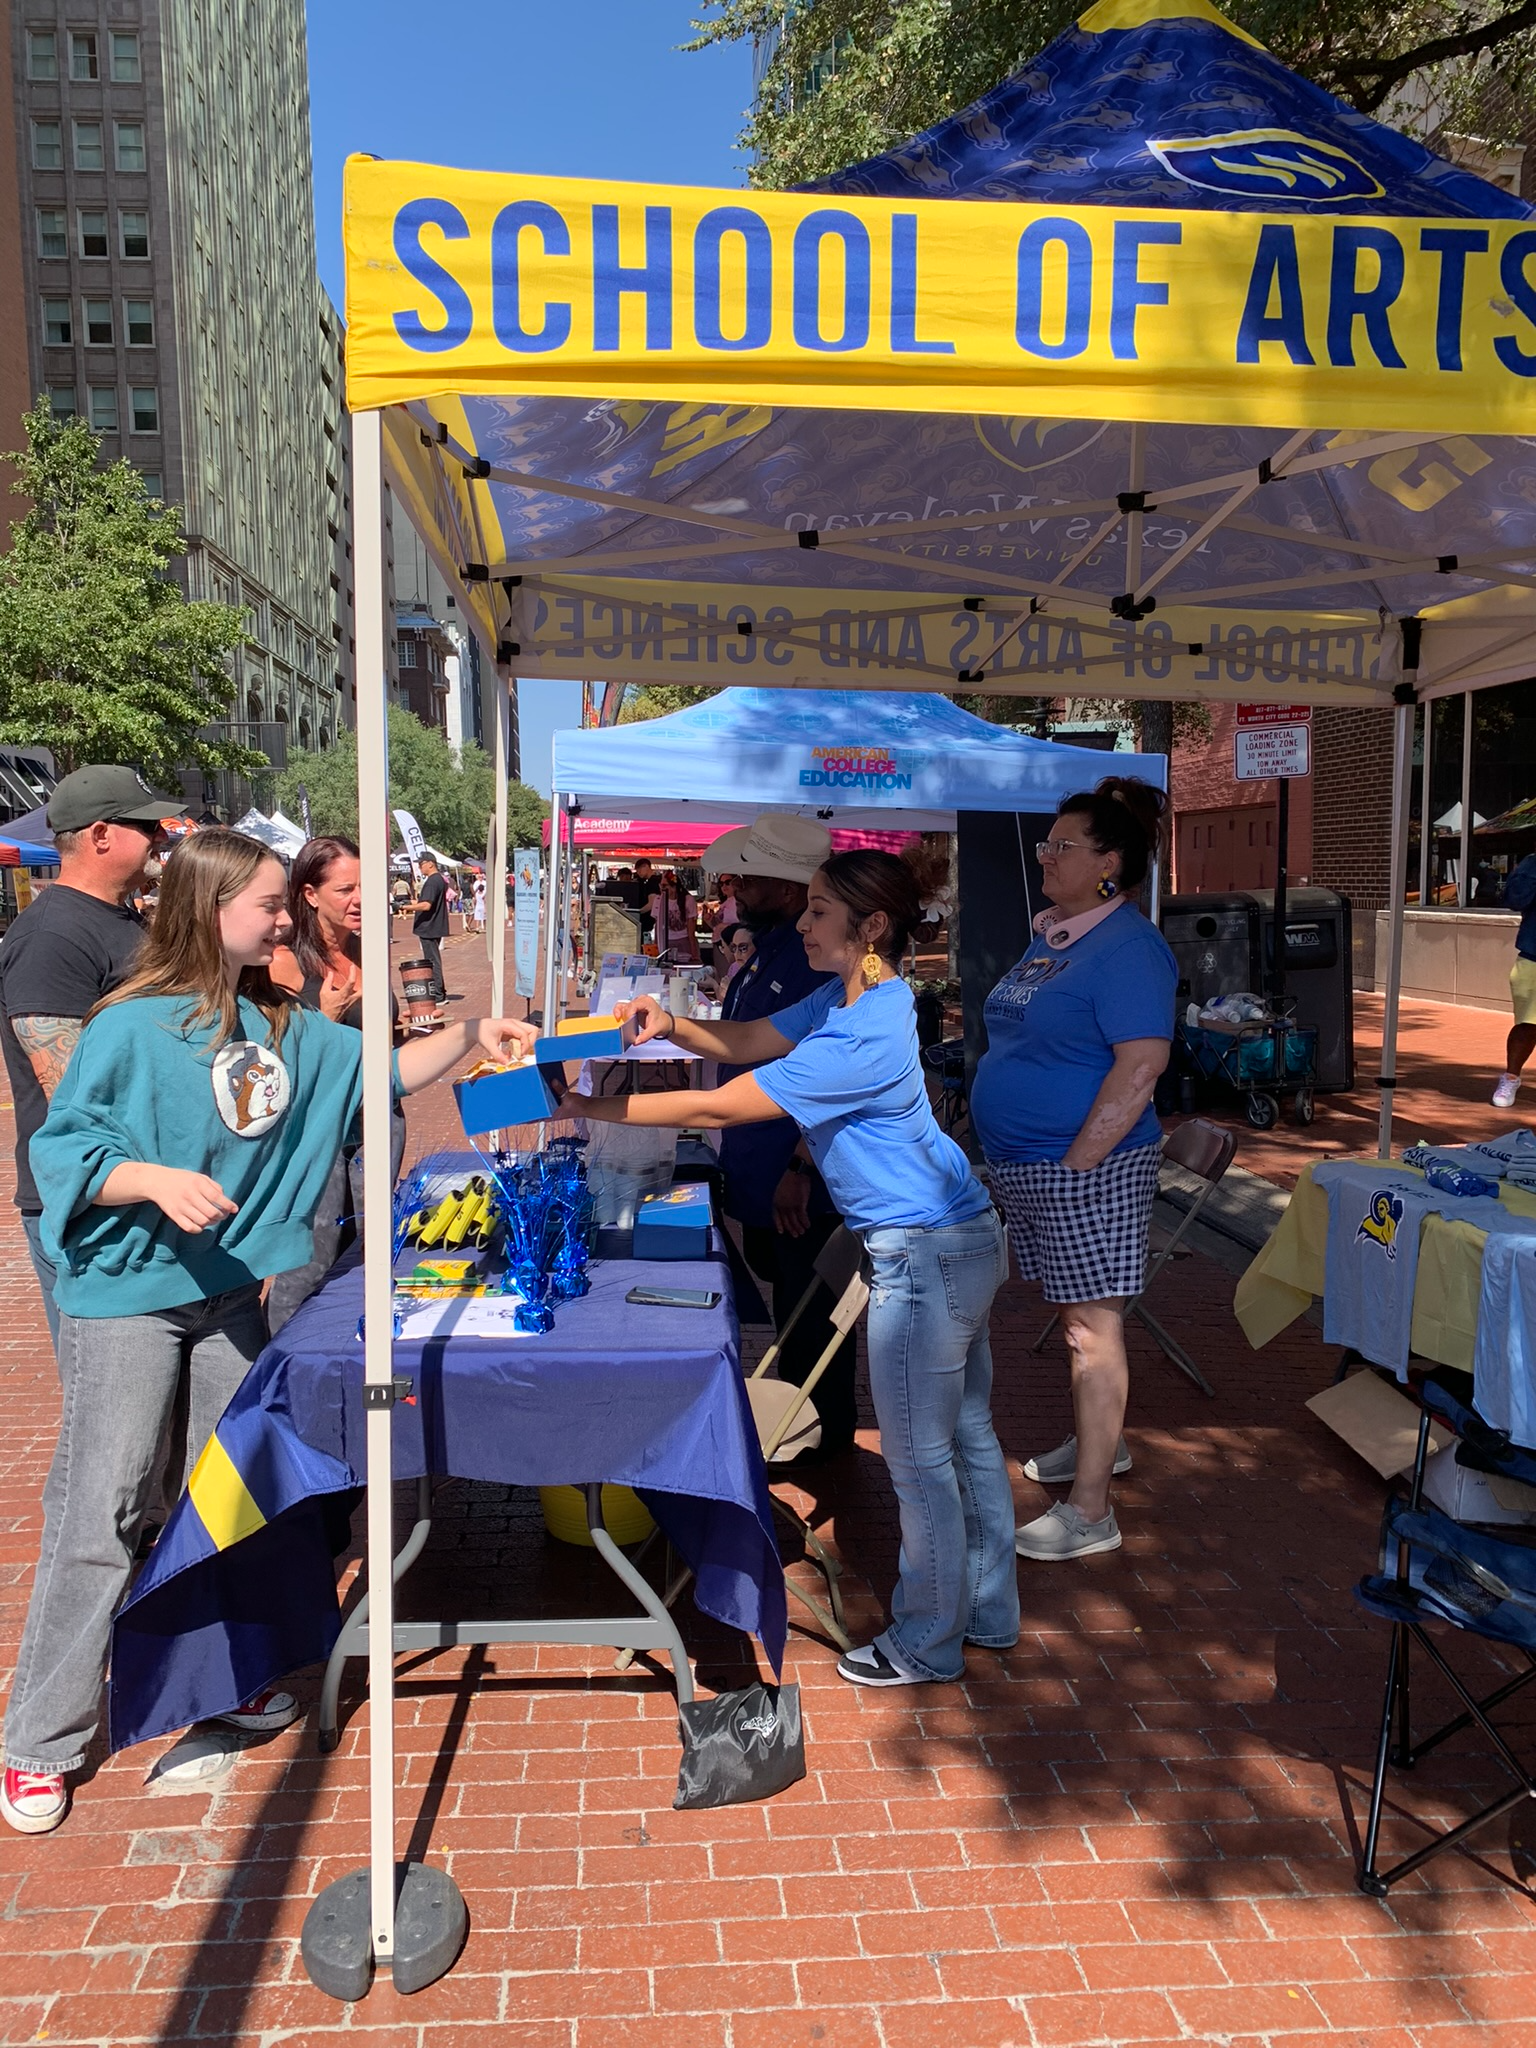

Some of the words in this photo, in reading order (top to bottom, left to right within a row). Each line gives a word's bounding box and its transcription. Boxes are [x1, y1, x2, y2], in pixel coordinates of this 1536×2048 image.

[392, 197, 957, 354] SCHOOL
[1014, 216, 1183, 361] OF
[1236, 223, 1536, 378] ARTS
[1248, 731, 1295, 742] COMMERCIAL
[1245, 740, 1276, 751] LOADING
[1279, 739, 1299, 748] ZONE
[811, 746, 889, 760] AMERICAN
[1247, 752, 1255, 760] 30
[1257, 750, 1279, 759] MINUTE
[1281, 748, 1297, 757] LIMIT
[823, 757, 897, 774] COLLEGE
[1257, 760, 1270, 768] TOW
[1271, 759, 1288, 767] AWAY
[1259, 767, 1279, 775] OTHER
[1281, 765, 1299, 773] TIMES
[798, 769, 912, 790] EDUCATION
[863, 788, 895, 798] FUND
[573, 818, 632, 832] Academy
[1403, 1146, 1432, 1164] ASK
